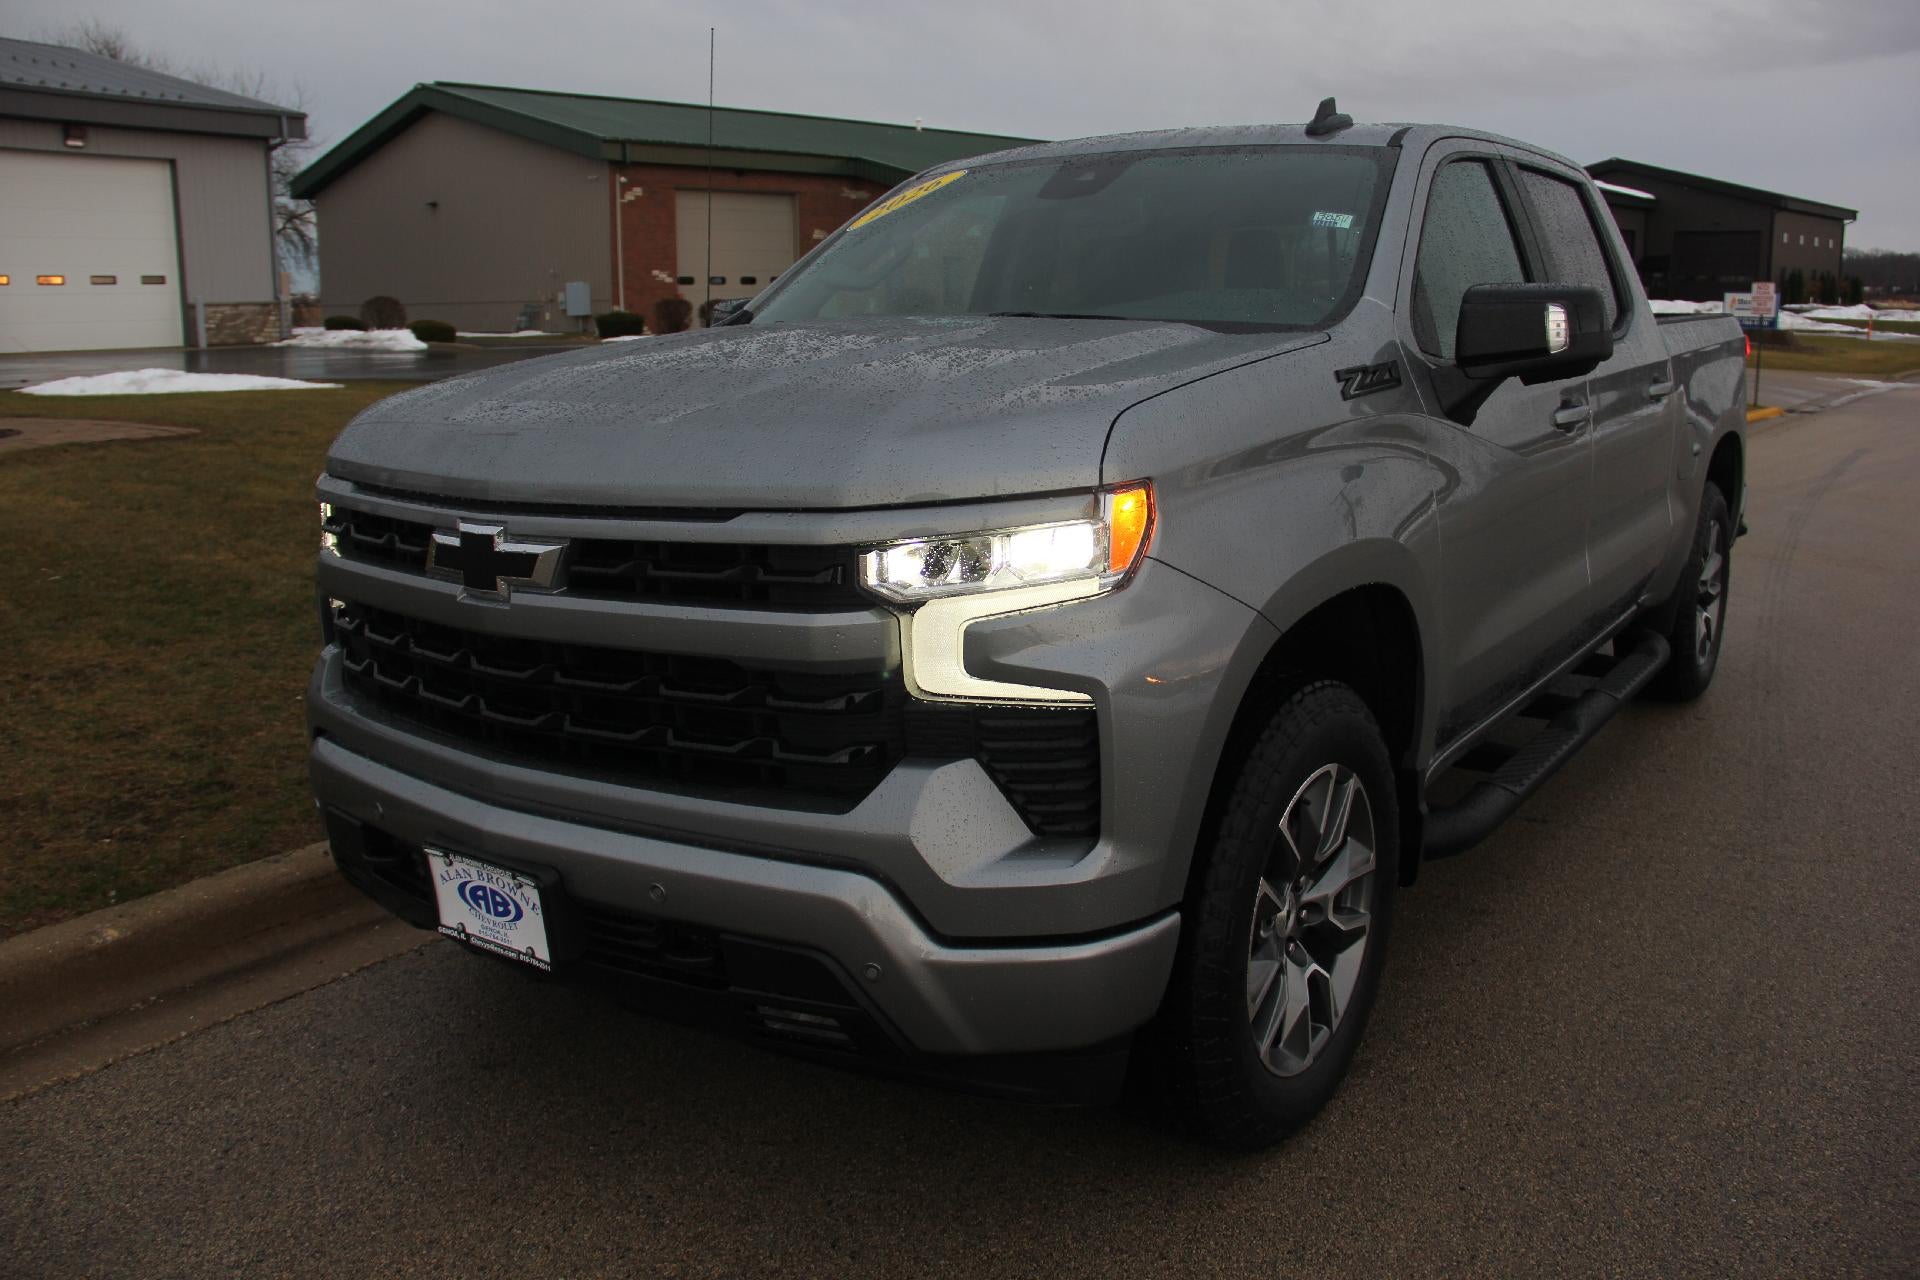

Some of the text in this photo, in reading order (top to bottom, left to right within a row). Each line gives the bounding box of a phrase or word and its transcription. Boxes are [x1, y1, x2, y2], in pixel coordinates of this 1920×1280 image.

[1334, 360, 1402, 401] Z71
[440, 866, 541, 916] ALAN BROWNE
[468, 884, 513, 919] AB
[469, 907, 519, 931] CHEVROLET
